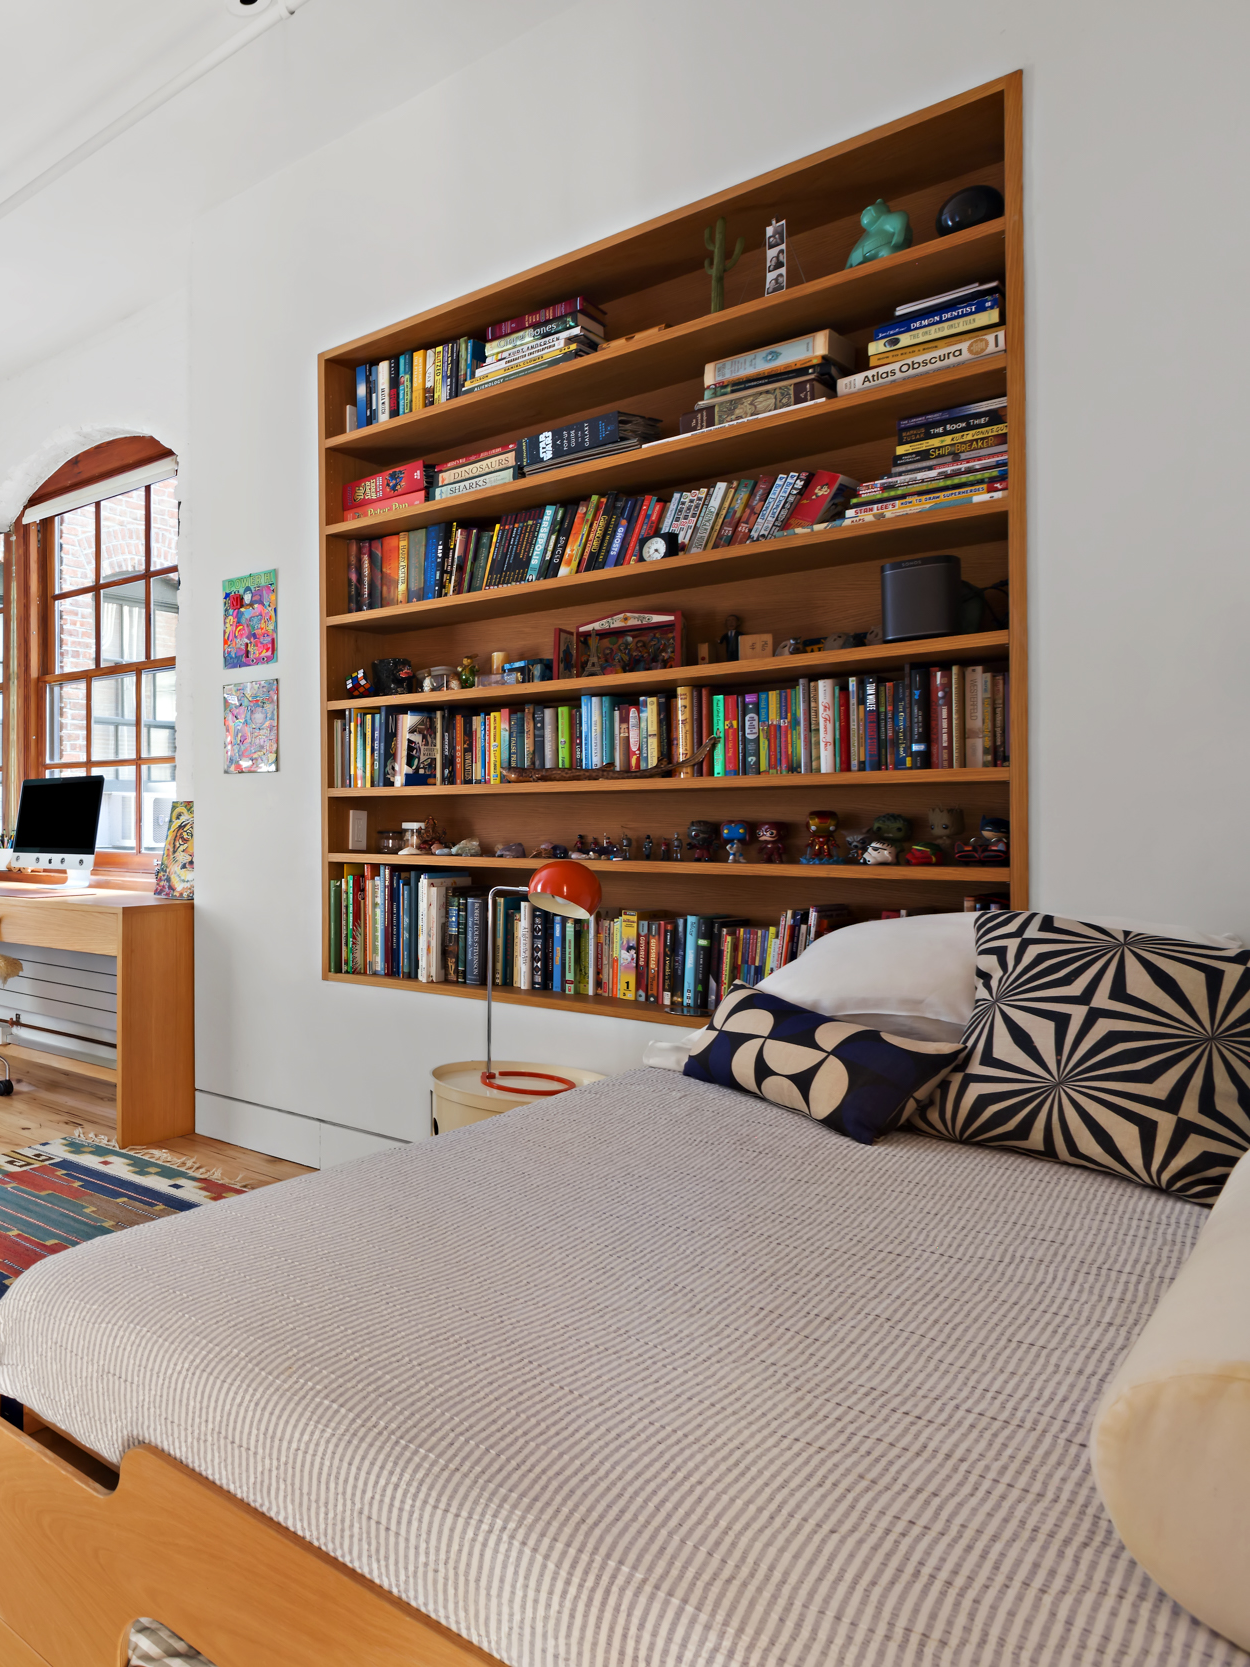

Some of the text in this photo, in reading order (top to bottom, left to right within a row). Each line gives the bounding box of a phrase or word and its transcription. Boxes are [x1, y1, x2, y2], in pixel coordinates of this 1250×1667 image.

[910, 305, 976, 329] DEMON DENTIST
[910, 332, 920, 340] THE
[934, 327, 945, 335] AND
[947, 322, 960, 332] ONLY
[962, 318, 976, 327] IVAN
[528, 323, 557, 338] Bones
[470, 356, 544, 383] WILSON DANIEL CLOWES
[862, 348, 963, 386] Atlas Obscura
[474, 379, 504, 392] ALIENOLOGY
[902, 428, 925, 436] MARKUS
[902, 433, 925, 441] ZUSAK
[930, 417, 990, 434] THE BOOK THIEF
[950, 425, 1008, 442] KURT VONNEGUT
[929, 437, 995, 459] SHIP BREAKER
[453, 456, 510, 480] DINOSAURS
[449, 478, 488, 495] SHARKS
[780, 482, 794, 493] BLUE
[367, 502, 408, 516] Peter Pan
[760, 483, 783, 521] BLUE EXORCIST
[768, 495, 788, 519] EXORCIST
[854, 506, 873, 515] STAN
[876, 503, 896, 512] LEE'S
[943, 487, 985, 499] SUPERHEROES
[531, 509, 552, 565] PERSEPOLIS
[591, 515, 608, 552] CARDBOARD
[598, 516, 616, 562] PRETTY MONSTERS
[694, 505, 717, 550] GREENGLASS HOUSE
[554, 536, 566, 563] SPLICED
[611, 527, 624, 555] GHOSTS
[227, 575, 262, 591] POWER
[866, 683, 876, 754] TOM WOLFE THE RIGHT STUFF
[625, 981, 629, 990] 1
